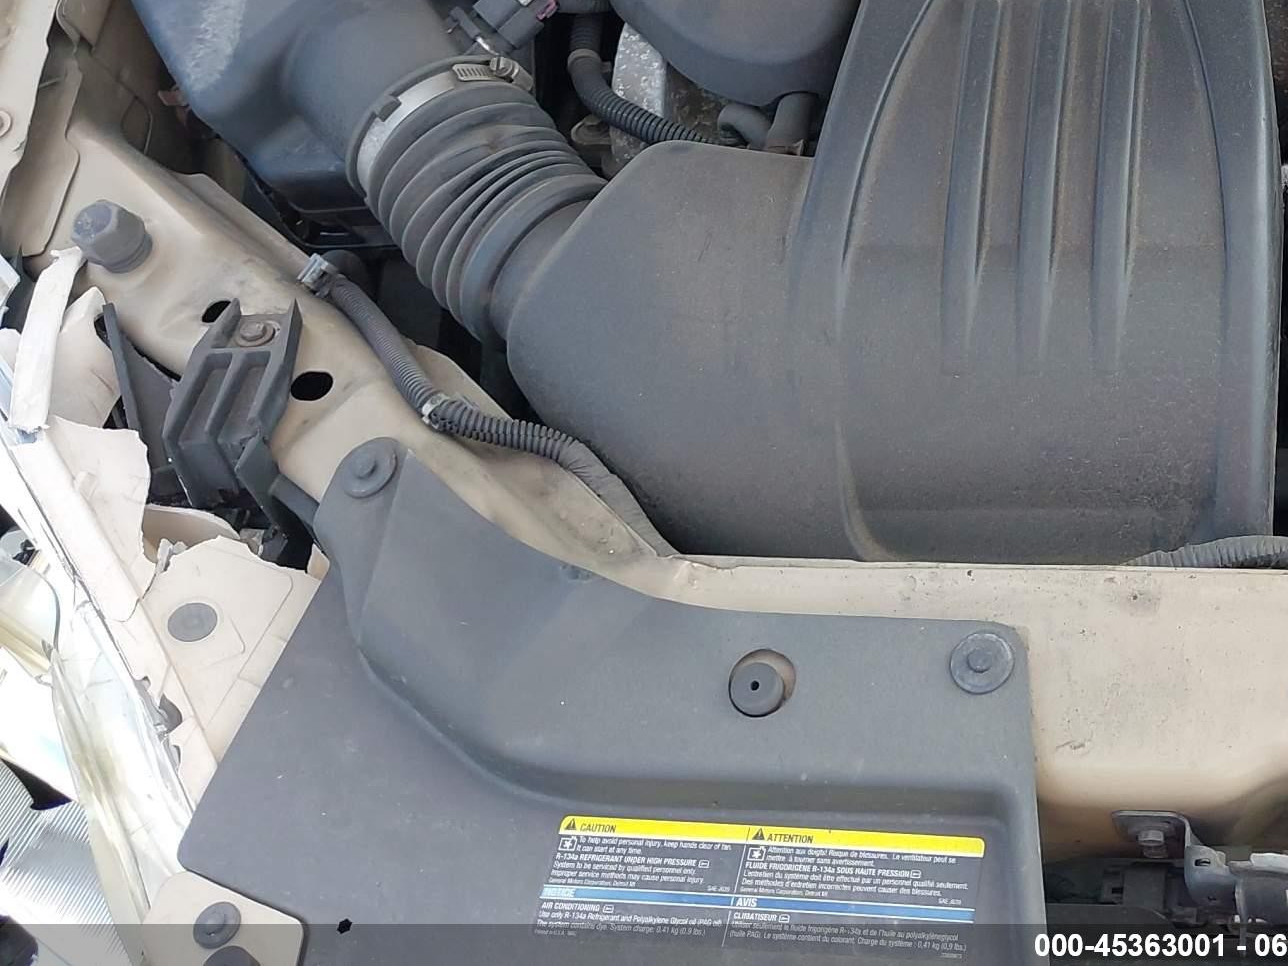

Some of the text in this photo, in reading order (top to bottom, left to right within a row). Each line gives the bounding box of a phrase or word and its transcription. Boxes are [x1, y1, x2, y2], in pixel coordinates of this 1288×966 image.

[579, 823, 616, 832] CAUTION
[616, 838, 644, 846] personal
[662, 840, 679, 848] keep
[767, 834, 812, 843] ATTENTION
[555, 852, 579, 860] R-134a
[578, 853, 623, 862] REFRIGERANT
[622, 855, 645, 863] UNDER
[662, 858, 697, 866] PRESSURE
[765, 854, 786, 862] mettre
[767, 846, 794, 854] Attention
[827, 849, 848, 858] Risque
[900, 853, 933, 861] ventilateur
[932, 855, 948, 863] peut
[552, 860, 576, 869] System
[591, 862, 618, 870] serviced
[616, 864, 626, 872] by
[625, 864, 653, 873] qualified
[651, 865, 683, 875] personnel
[744, 861, 768, 869] FLUIDE
[811, 865, 836, 873] R-134a
[835, 866, 855, 874] SOUS
[854, 867, 876, 875] HAUTE
[876, 868, 910, 877] PRESSION
[550, 869, 578, 877] Improper
[600, 871, 627, 879] methods
[658, 875, 686, 883] personal
[783, 872, 810, 881] système
[881, 877, 912, 886] personnel
[754, 879, 784, 887] méthodes
[850, 884, 877, 893] peuvent
[541, 901, 600, 911] AIR CONDITIONING
[735, 897, 758, 907] AVIS
[549, 910, 564, 919] only
[563, 911, 587, 919] R-134a
[586, 912, 620, 922] Refrigerant
[619, 914, 633, 922] and
[631, 915, 670, 925] Polyalkylene
[668, 917, 689, 926] Glycol
[732, 911, 778, 921] CLIMATISEUR
[546, 919, 568, 928] system
[567, 920, 596, 929] contains
[608, 923, 633, 932] System
[669, 926, 681, 935] kg
[753, 921, 783, 930] seulement
[763, 931, 772, 939] Le
[796, 933, 822, 942] contient
[820, 934, 830, 942] du
[856, 936, 879, 946] Charge
[930, 941, 940, 950] kg
